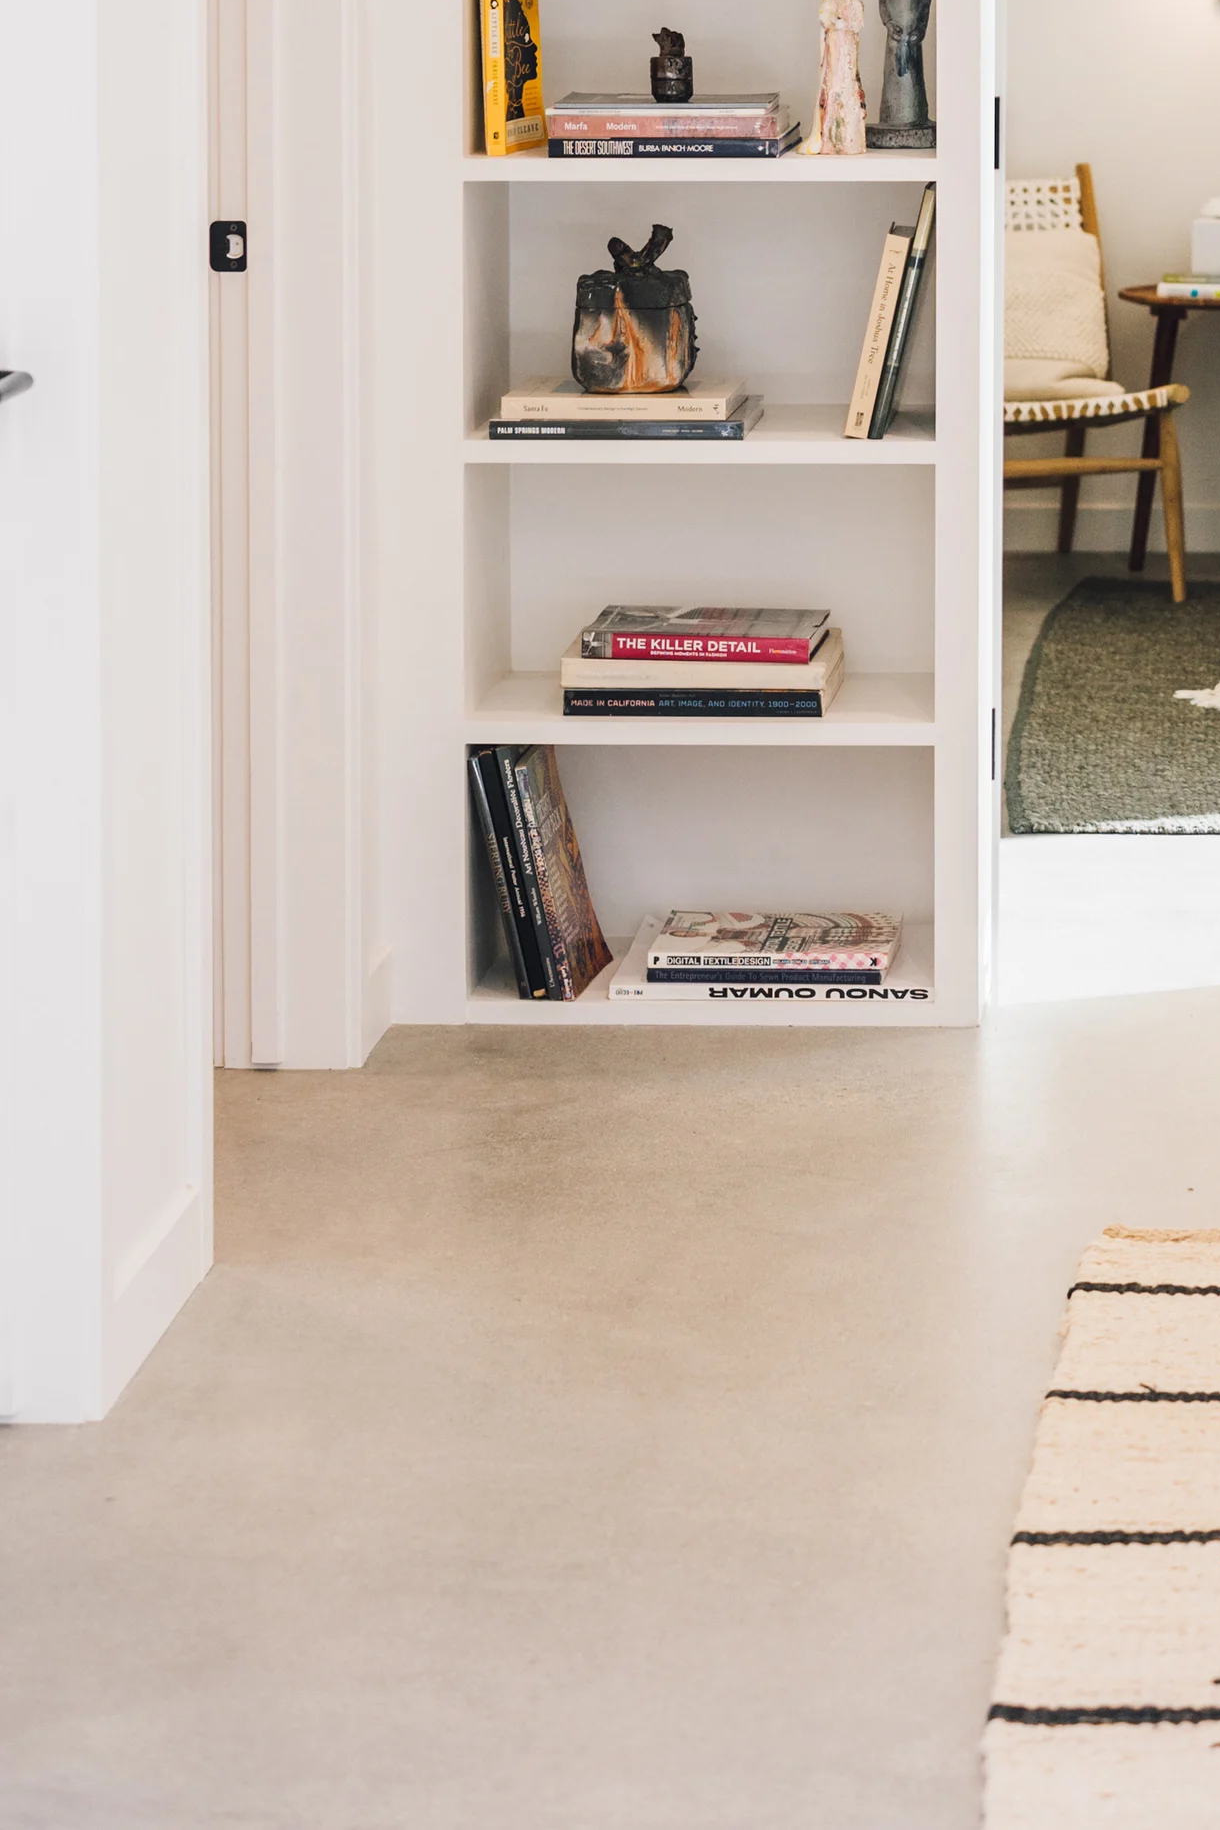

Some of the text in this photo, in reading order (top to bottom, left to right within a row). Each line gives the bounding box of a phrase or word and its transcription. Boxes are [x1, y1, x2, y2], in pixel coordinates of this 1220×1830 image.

[564, 122, 636, 130] Marfa Modern
[563, 140, 634, 155] THE DESERT SOUTHWEST
[638, 144, 714, 152] BURBA PANICH MOORE
[888, 263, 896, 273] At
[881, 276, 894, 301] Home
[880, 304, 888, 312] in
[872, 313, 886, 342] Joshua
[868, 346, 880, 364] Tree
[617, 638, 761, 653] THE KILLER DETAIL
[659, 700, 675, 708] ART,
[678, 700, 706, 708] IMAGE,
[708, 700, 725, 708] AND
[728, 700, 765, 708] IDENTITY,
[504, 758, 534, 876] Art Nouveau Decorative Flowers
[487, 833, 512, 914] STERLING RUBY
[667, 956, 700, 965] DIGITAL
[704, 956, 737, 965] TEXTILE
[738, 956, 770, 965] DESIGN
[655, 971, 866, 983] The Entrepreneur's Guide To Sewn Product Manufacturing
[708, 988, 928, 1000] SANOU OUMAR
